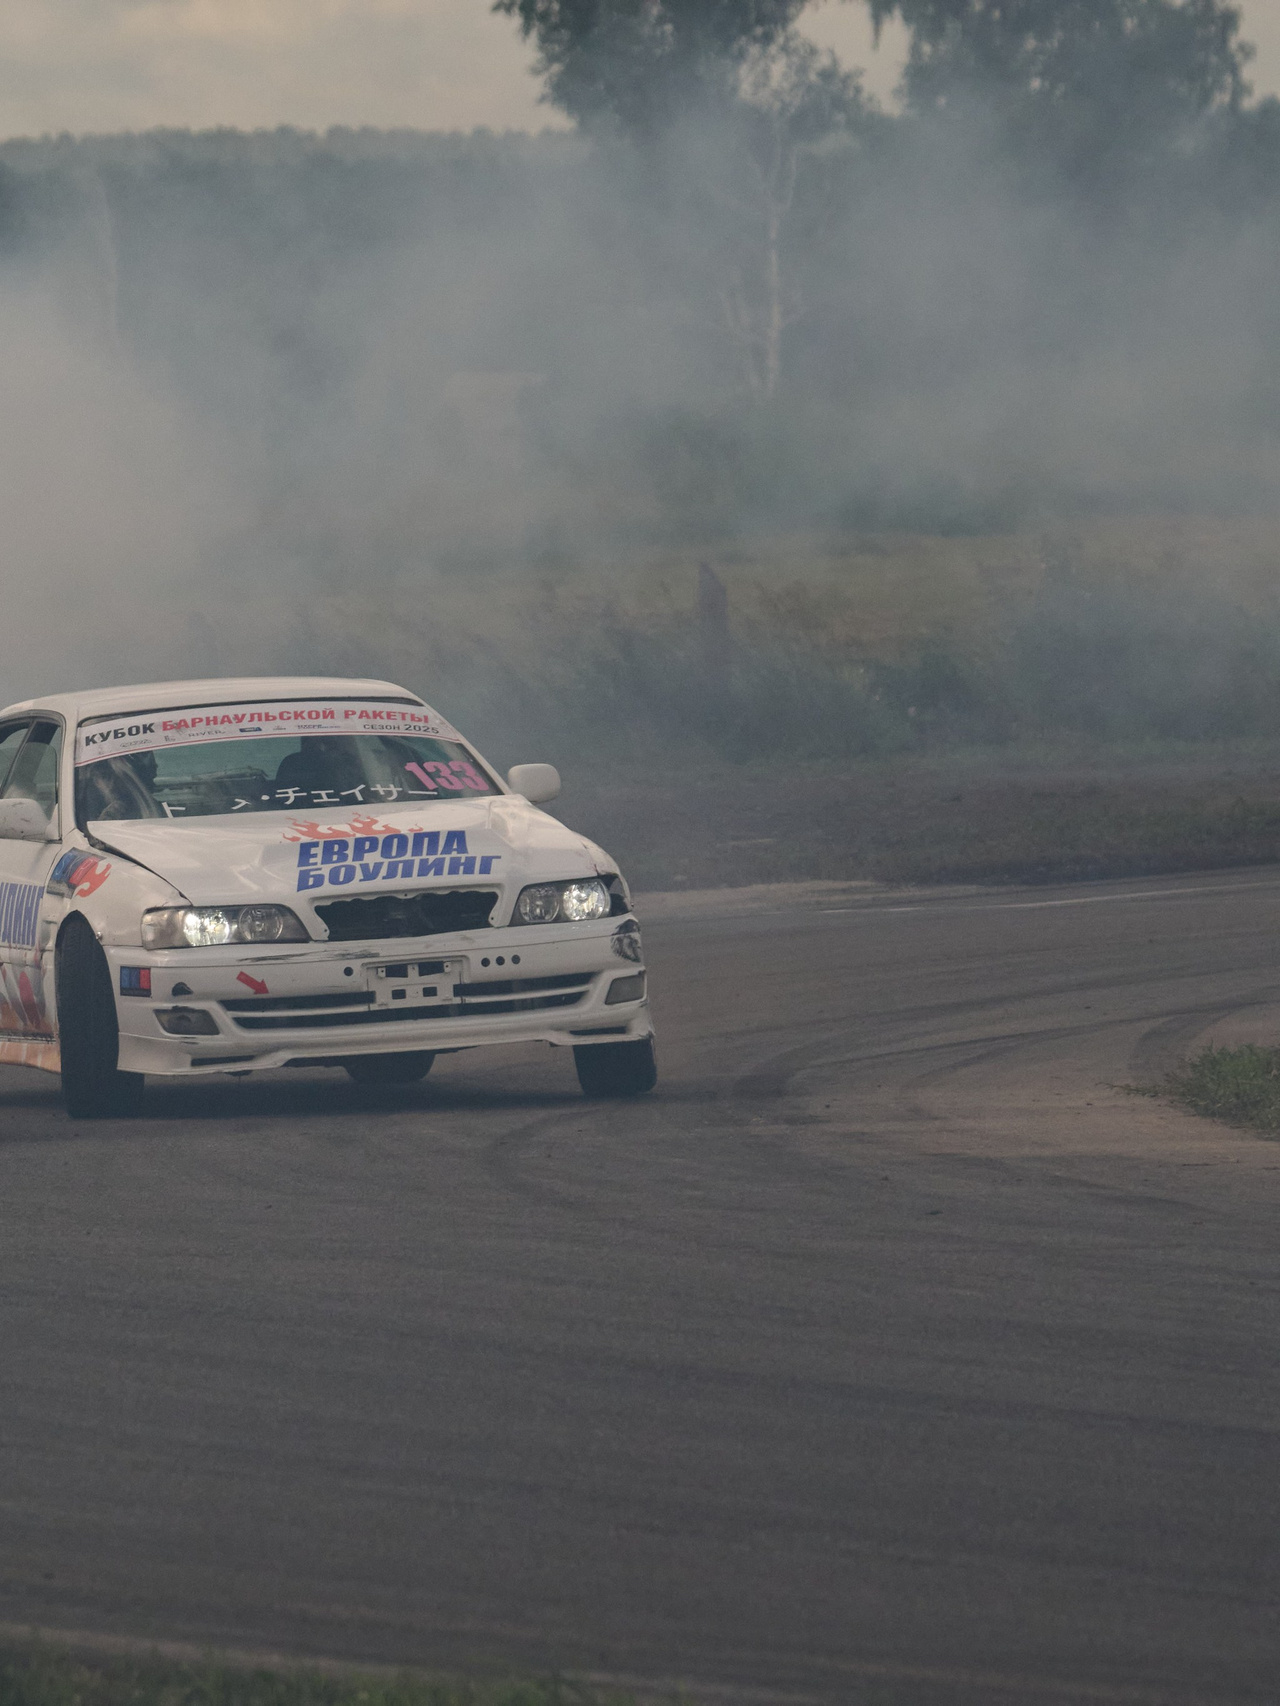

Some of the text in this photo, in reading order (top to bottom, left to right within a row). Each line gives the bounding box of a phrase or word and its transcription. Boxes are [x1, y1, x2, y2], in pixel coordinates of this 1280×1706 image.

[85, 722, 155, 747] КУБОК
[162, 707, 335, 731] БАРНАУЛЬСКОЙ
[344, 709, 430, 724] РАКЕТЫ
[404, 724, 440, 735] 2025
[404, 761, 490, 791] 133
[297, 830, 469, 868] ЕВРОПА
[297, 855, 502, 892] БОУЛИНГ
